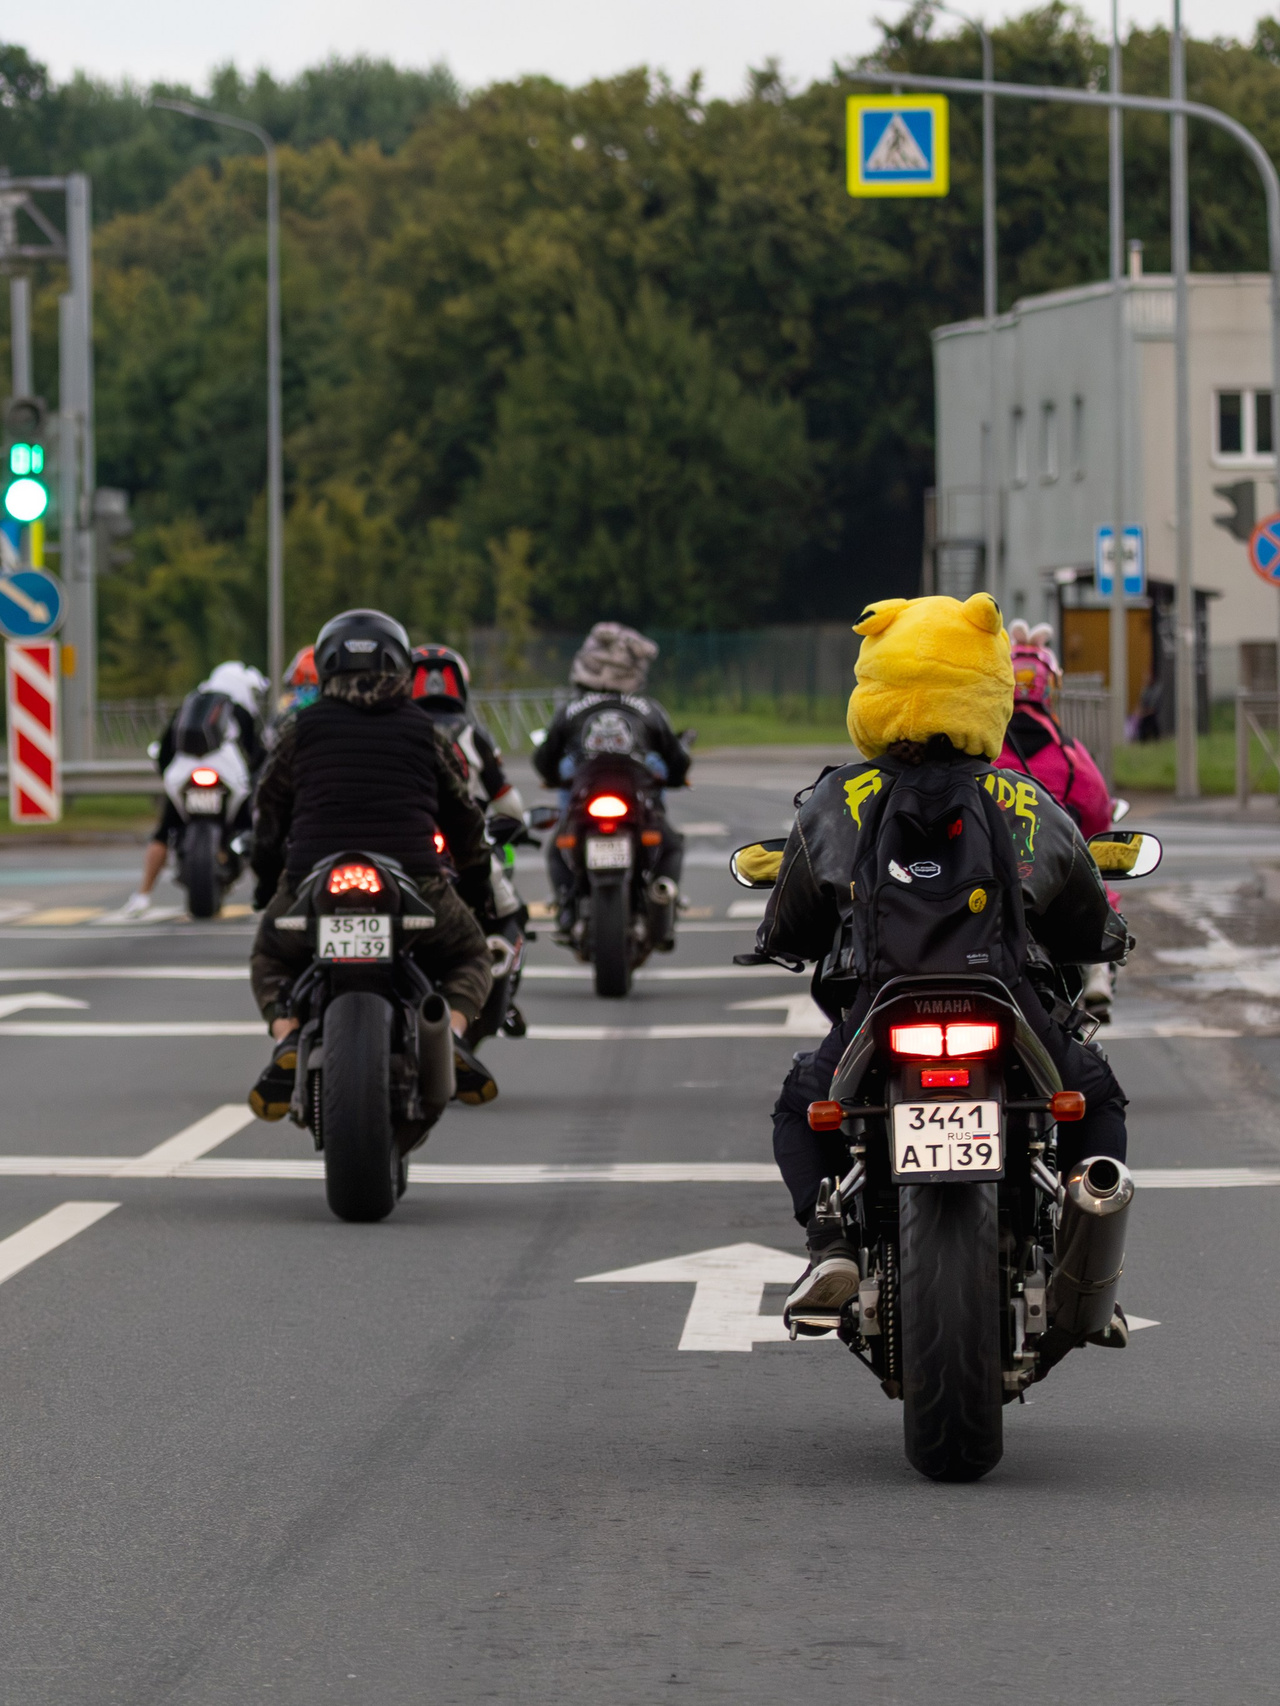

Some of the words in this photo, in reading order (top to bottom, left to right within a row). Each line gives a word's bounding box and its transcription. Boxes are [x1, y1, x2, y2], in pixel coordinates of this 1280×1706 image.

[329, 918, 380, 934] 3510
[360, 941, 386, 957] 39
[914, 999, 972, 1014] YAMAHA
[908, 1104, 983, 1131] 3441
[947, 1131, 972, 1141] RUS
[956, 1142, 993, 1168] 39
